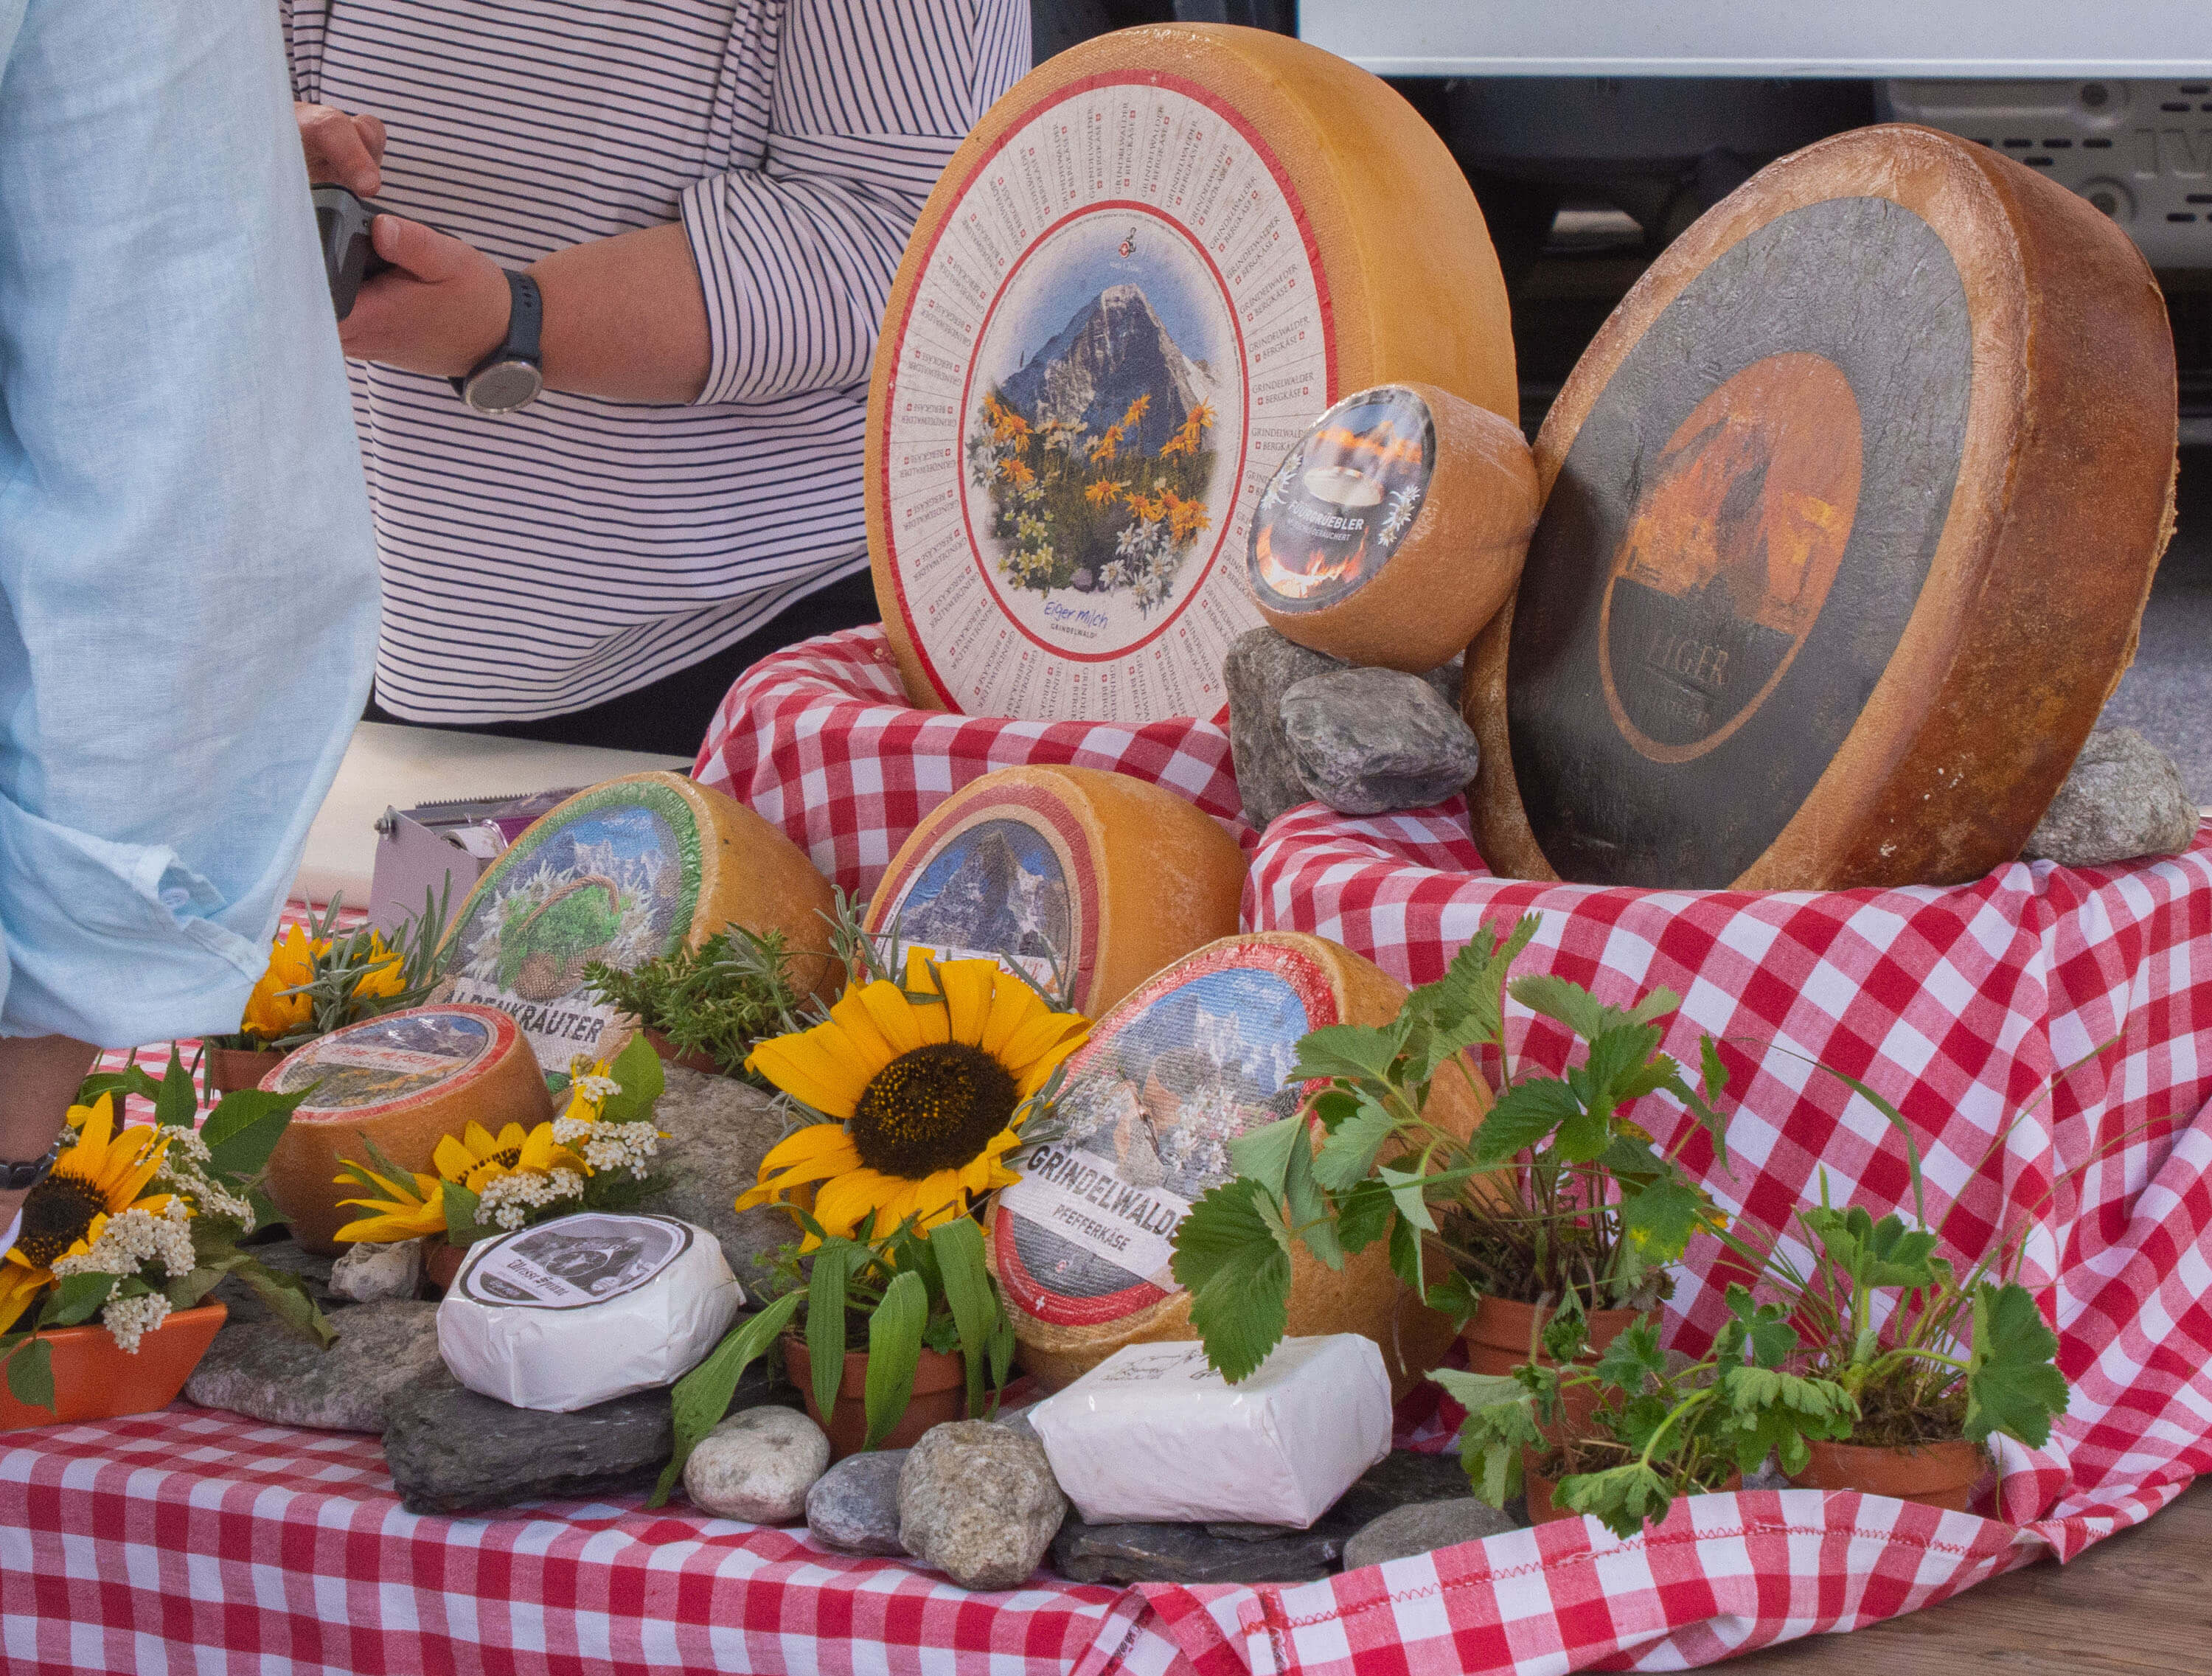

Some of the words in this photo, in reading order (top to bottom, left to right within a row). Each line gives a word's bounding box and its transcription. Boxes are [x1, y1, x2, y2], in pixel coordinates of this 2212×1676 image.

[1209, 176, 1256, 249] GRINDELWALDER
[1226, 216, 1281, 279] GRINDELWALDER
[1240, 263, 1298, 315] GRINDELWALDER
[1249, 316, 1310, 353] GRINDELWALDER
[1252, 372, 1315, 394] GRINDELWALDER
[1251, 427, 1304, 438] GRINDELWALD
[1263, 442, 1290, 451] BERGKÄ
[1043, 600, 1077, 622] Eiger
[1161, 637, 1186, 714] GRINDELWALDE
[1183, 613, 1220, 690] GRINDELWALDER
[1012, 650, 1037, 720] GRINDELWAL
[1039, 678, 1052, 719] BERGKÄ
[1047, 662, 1063, 718] GRINDELW
[1070, 686, 1079, 720] BERGK
[1079, 667, 1089, 720] GRINDELW
[1130, 678, 1141, 718] BERGKÄ
[1136, 654, 1151, 722] GRINDELWAL
[1027, 1145, 1186, 1242] GRINDELWALDE
[1052, 1203, 1132, 1251] PFEFFERKÄSE
